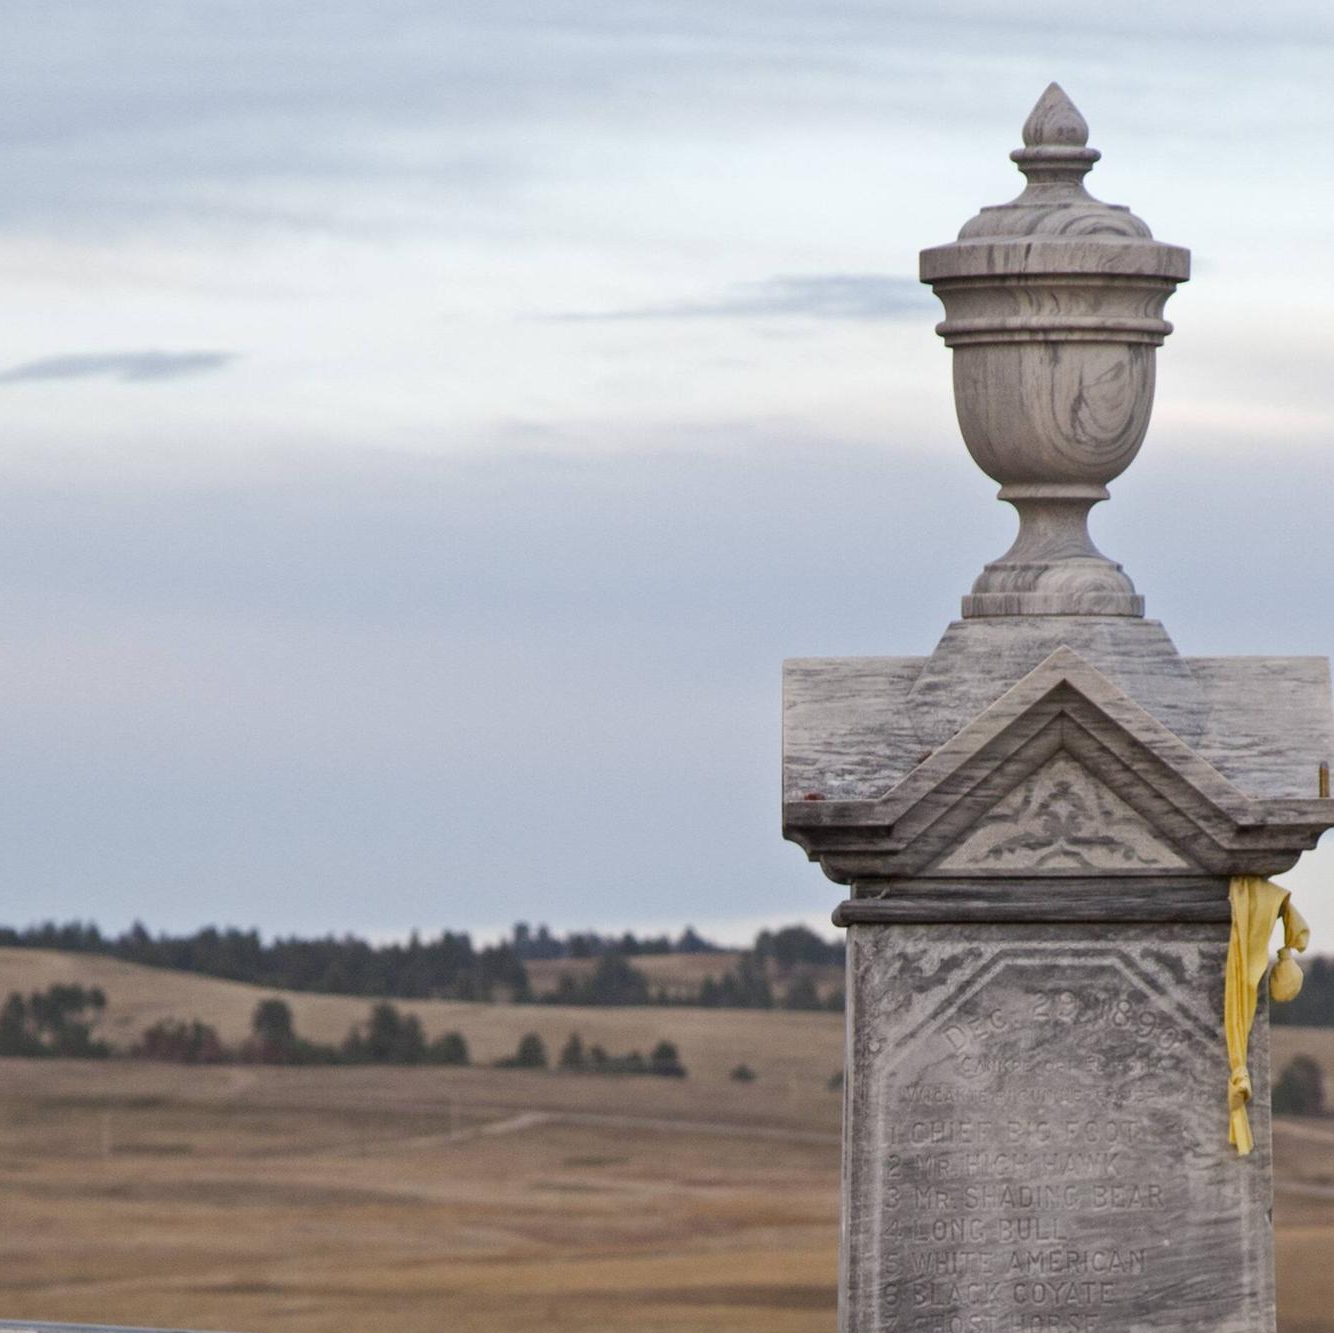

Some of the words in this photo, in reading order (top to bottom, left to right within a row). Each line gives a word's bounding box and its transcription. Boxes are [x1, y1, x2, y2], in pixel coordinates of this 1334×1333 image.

[911, 1120, 992, 1145] CHIEF
[1007, 1120, 1051, 1144] BIG
[1065, 1119, 1140, 1143] FOOT
[886, 1153, 902, 1178] 2
[966, 1152, 1028, 1177] HIGH
[1046, 1152, 1121, 1177] HAWK
[885, 1186, 901, 1209] 3
[964, 1185, 1079, 1210] SHADING
[1092, 1183, 1165, 1209] BEAR
[887, 1218, 903, 1241] 4
[913, 1217, 985, 1242] LONG
[998, 1217, 1068, 1241] BULL
[886, 1252, 902, 1275] 5
[911, 1251, 994, 1275] WHITE
[1008, 1249, 1146, 1274] AMERICAN
[885, 1282, 900, 1307] 6
[913, 1281, 1000, 1307] BLACK
[1014, 1281, 1115, 1306] COYATE
